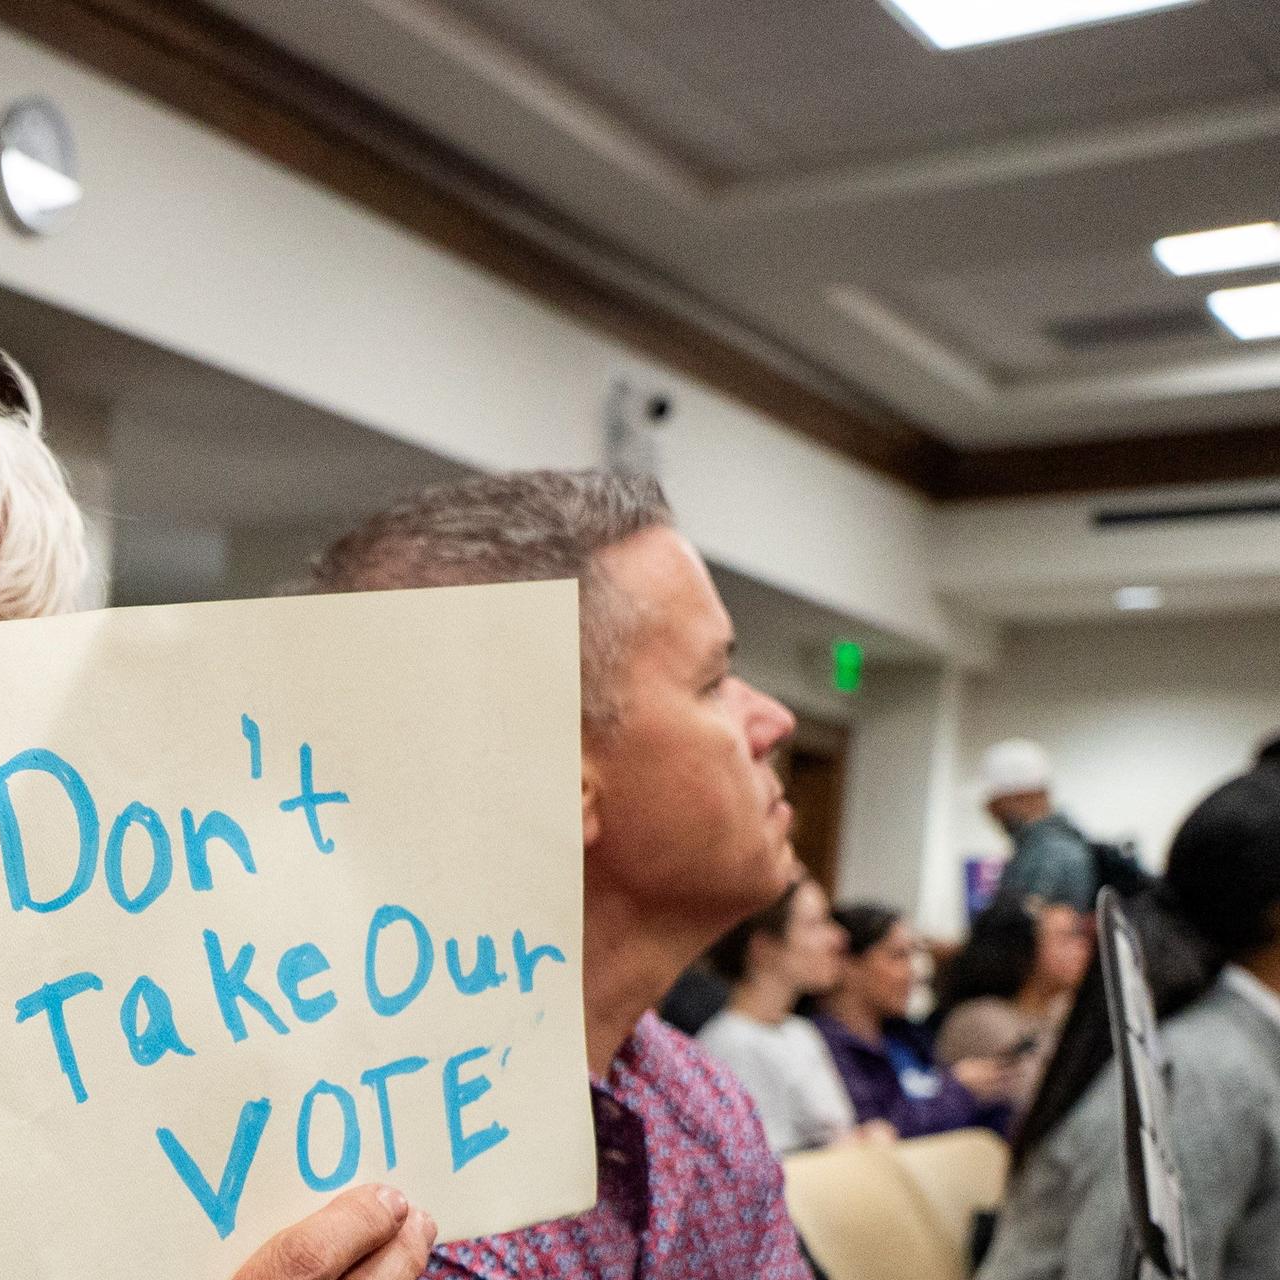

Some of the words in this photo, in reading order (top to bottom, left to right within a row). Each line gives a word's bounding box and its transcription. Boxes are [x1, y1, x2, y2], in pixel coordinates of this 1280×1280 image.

[14, 928, 339, 1104] Take
[364, 903, 567, 1018] Our
[155, 1046, 511, 1240] VOTE
